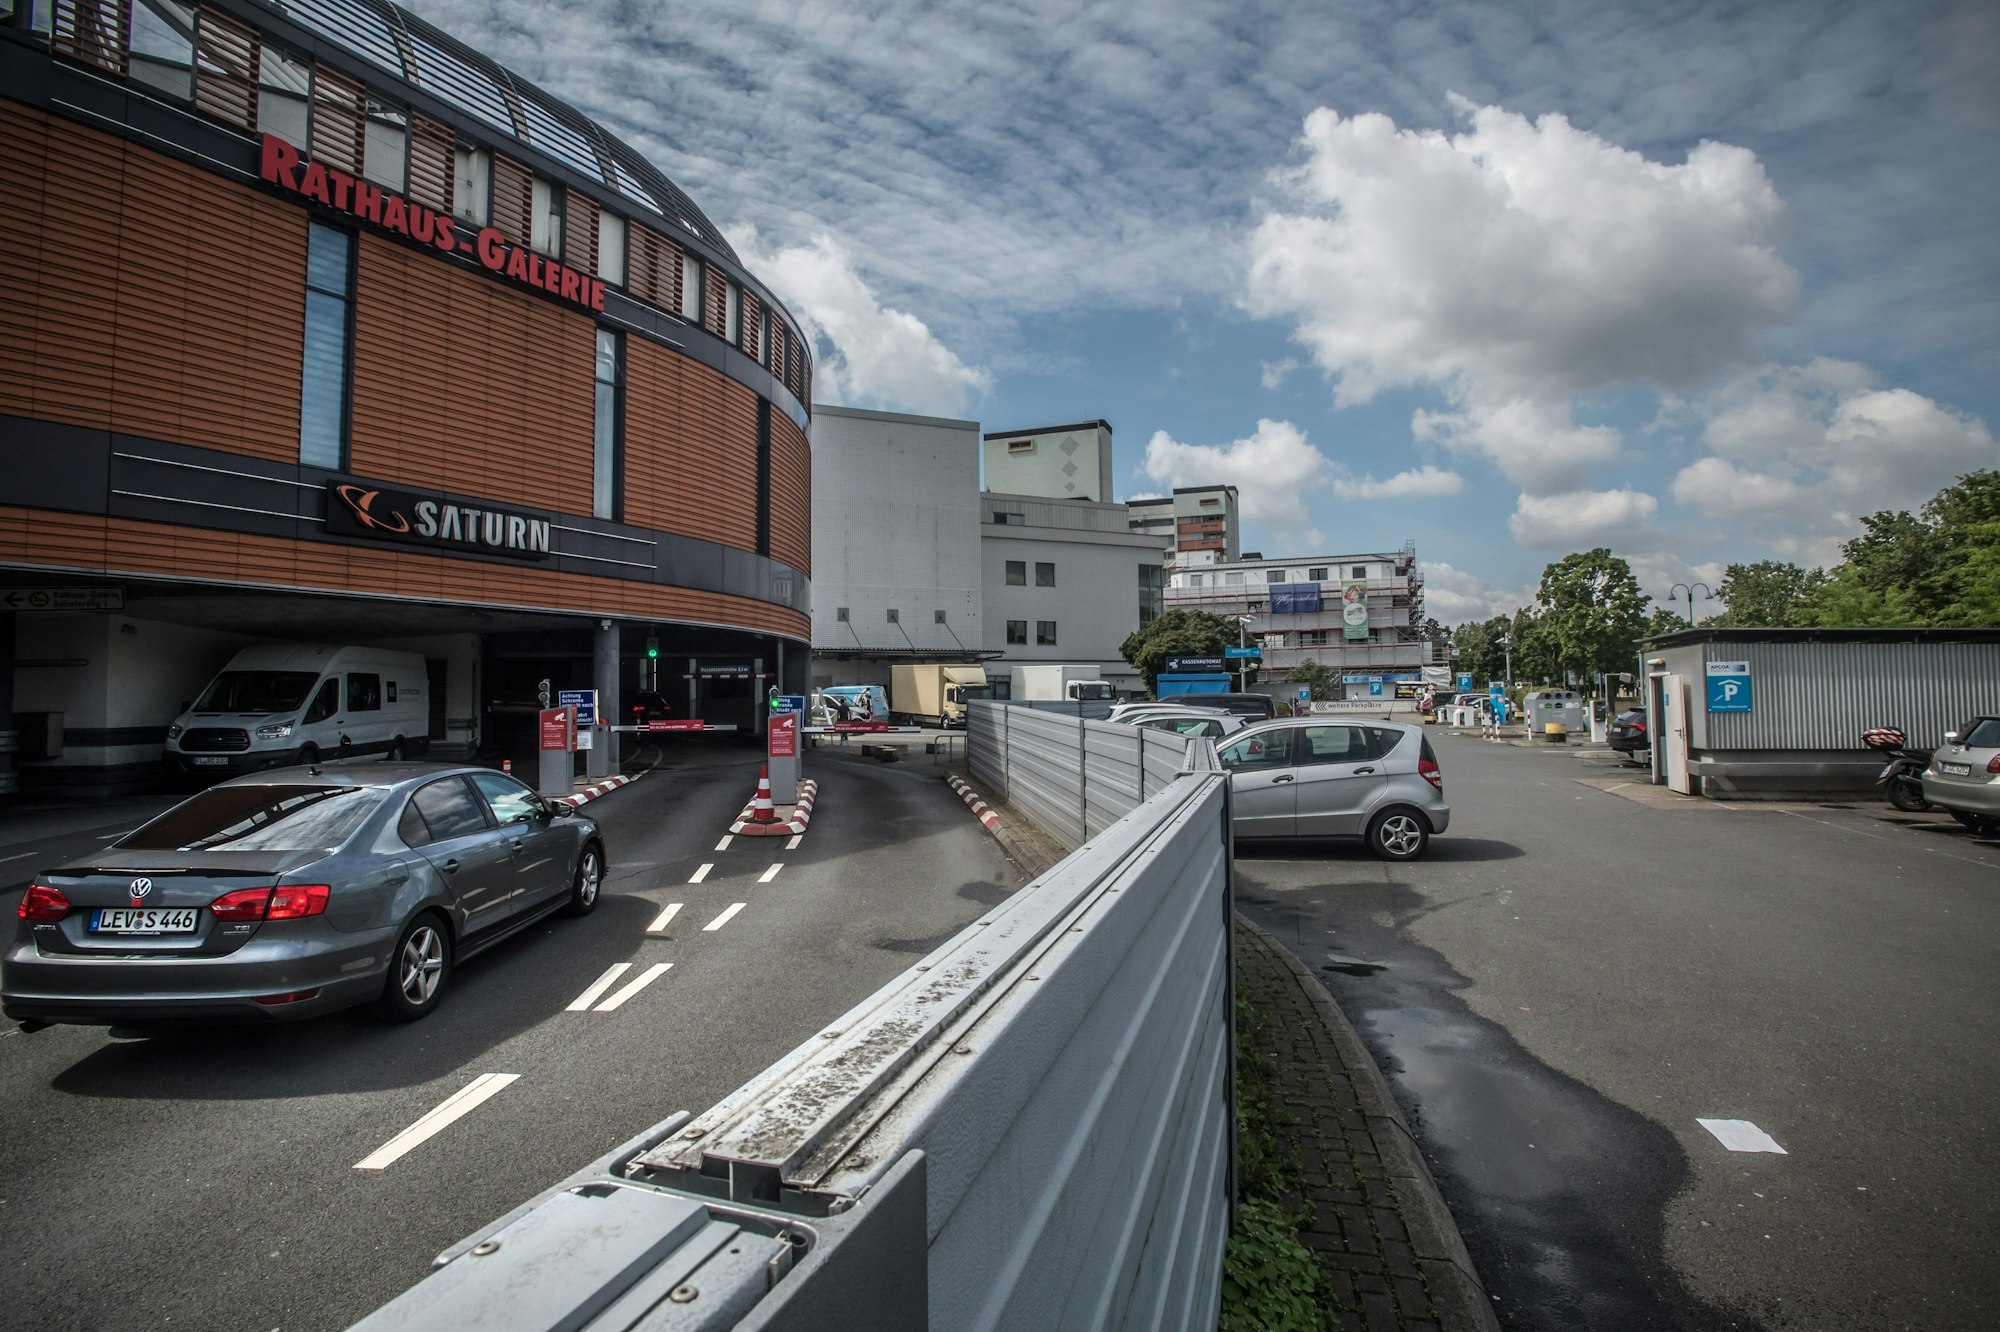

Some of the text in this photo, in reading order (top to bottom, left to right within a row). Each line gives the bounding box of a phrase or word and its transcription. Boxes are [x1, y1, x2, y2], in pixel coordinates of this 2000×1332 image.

[414, 500, 550, 554] SATURN
[53, 590, 119, 599] Rathaus-Galerie
[53, 599, 101, 609] Anlieferung
[1725, 684, 1738, 701] P
[1350, 701, 1382, 710] Parkplätze
[100, 910, 194, 929] LEV S 446
